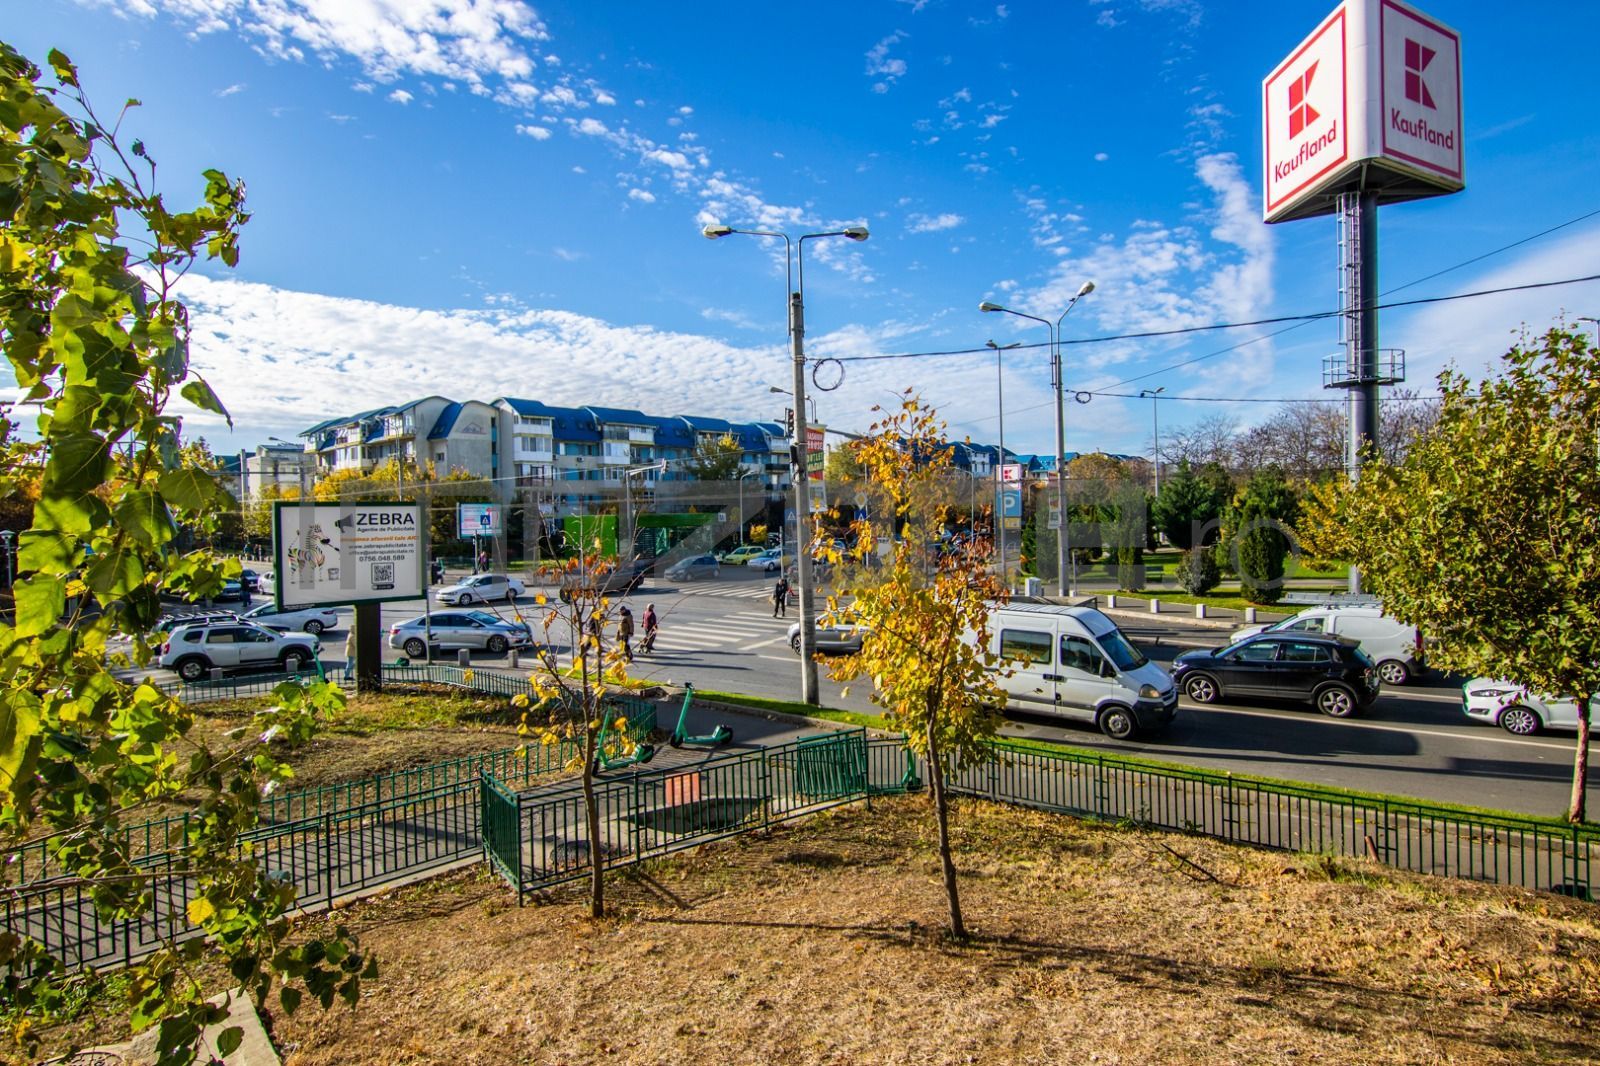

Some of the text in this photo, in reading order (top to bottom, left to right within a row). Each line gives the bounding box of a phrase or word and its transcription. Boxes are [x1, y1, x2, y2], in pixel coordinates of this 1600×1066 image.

[1391, 107, 1454, 150] Kaufland
[1274, 120, 1337, 183] Kaufland
[357, 513, 414, 525] ZEBRA
[1004, 496, 1015, 515] P
